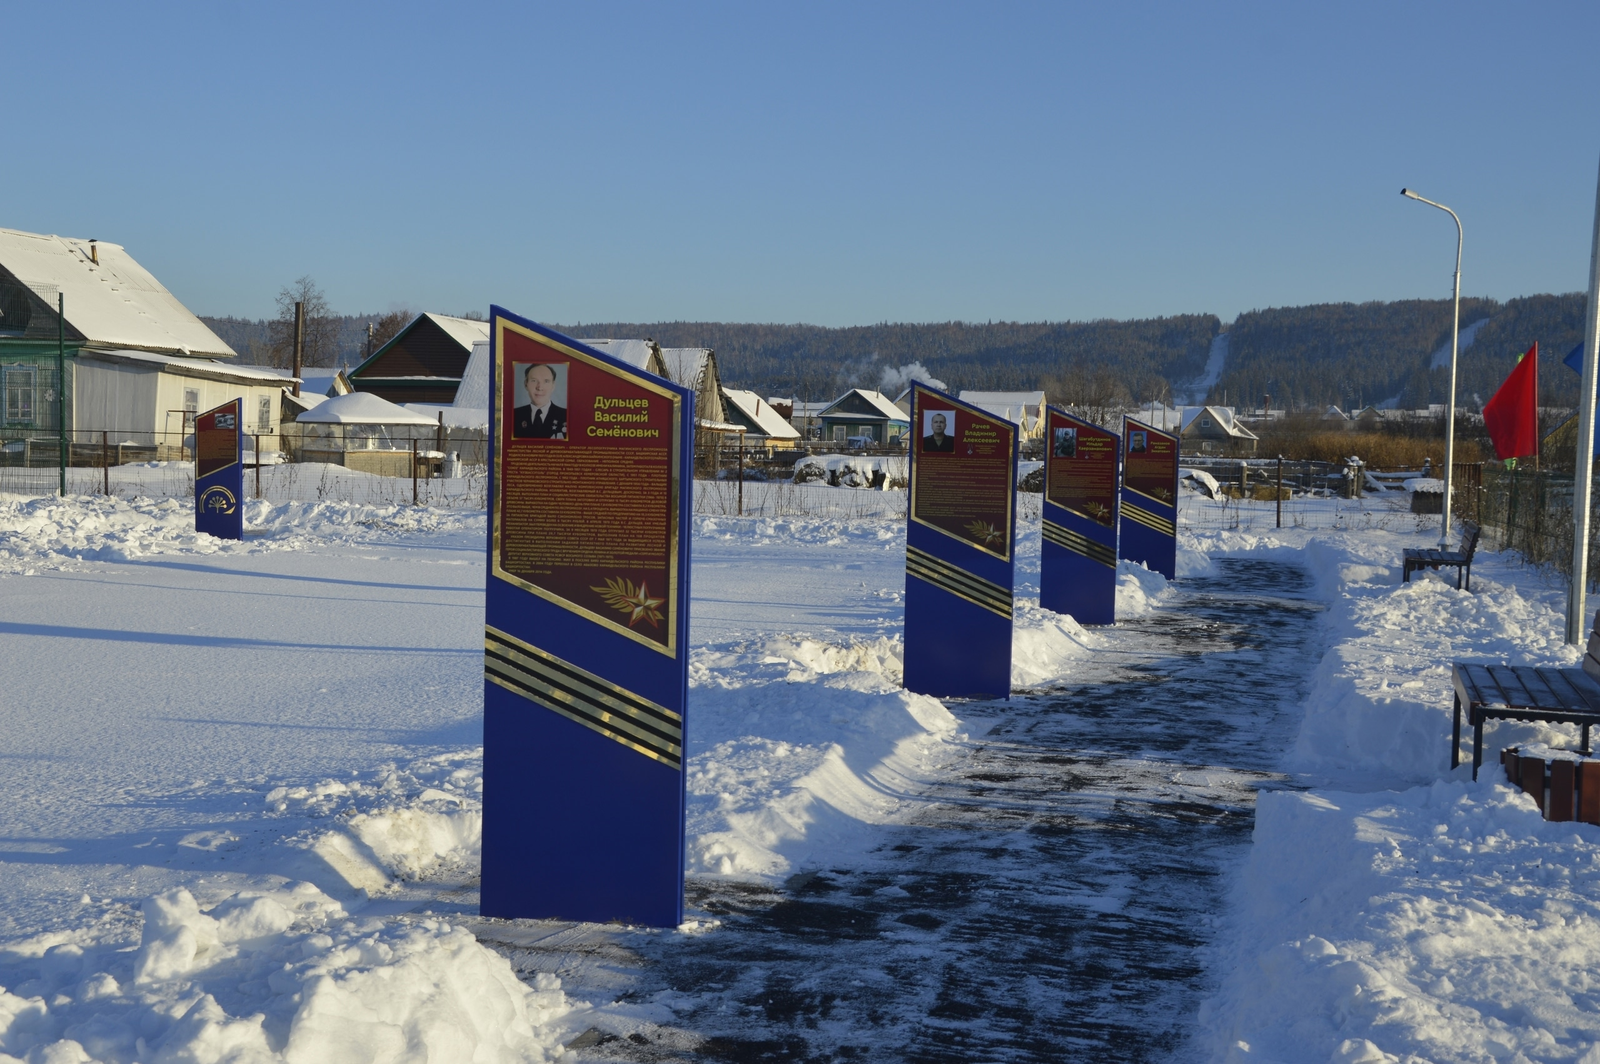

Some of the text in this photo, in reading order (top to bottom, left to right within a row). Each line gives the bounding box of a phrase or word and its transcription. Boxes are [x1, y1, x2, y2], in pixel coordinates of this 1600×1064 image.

[594, 396, 649, 409] Дульцев
[594, 411, 648, 423] Василий
[587, 425, 659, 438] Семёнович
